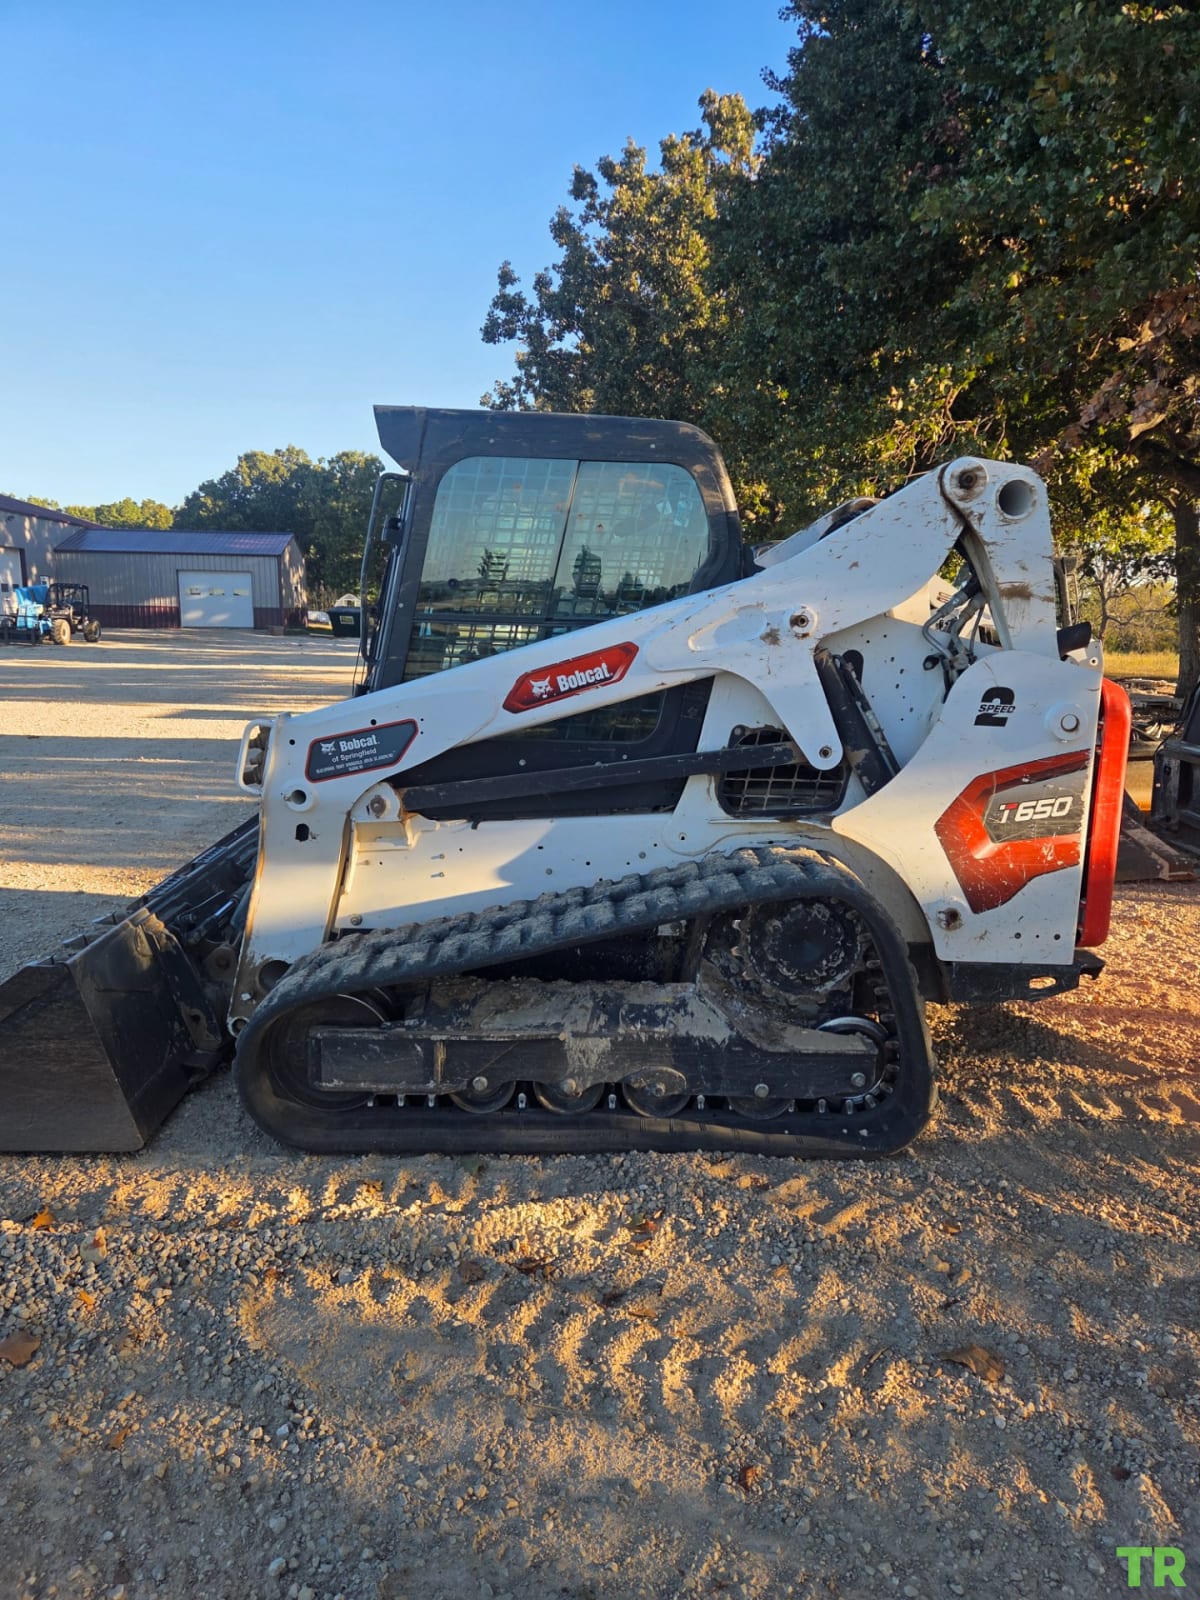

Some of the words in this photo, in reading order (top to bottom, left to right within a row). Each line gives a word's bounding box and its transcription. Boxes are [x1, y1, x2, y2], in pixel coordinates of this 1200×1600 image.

[556, 662, 610, 692] Bobcat
[974, 686, 1015, 727] 2
[977, 704, 1016, 714] SPEED
[339, 734, 378, 752] Bobcat
[331, 754, 339, 763] of
[340, 748, 377, 761] Springfield
[1000, 797, 1073, 823] T650
